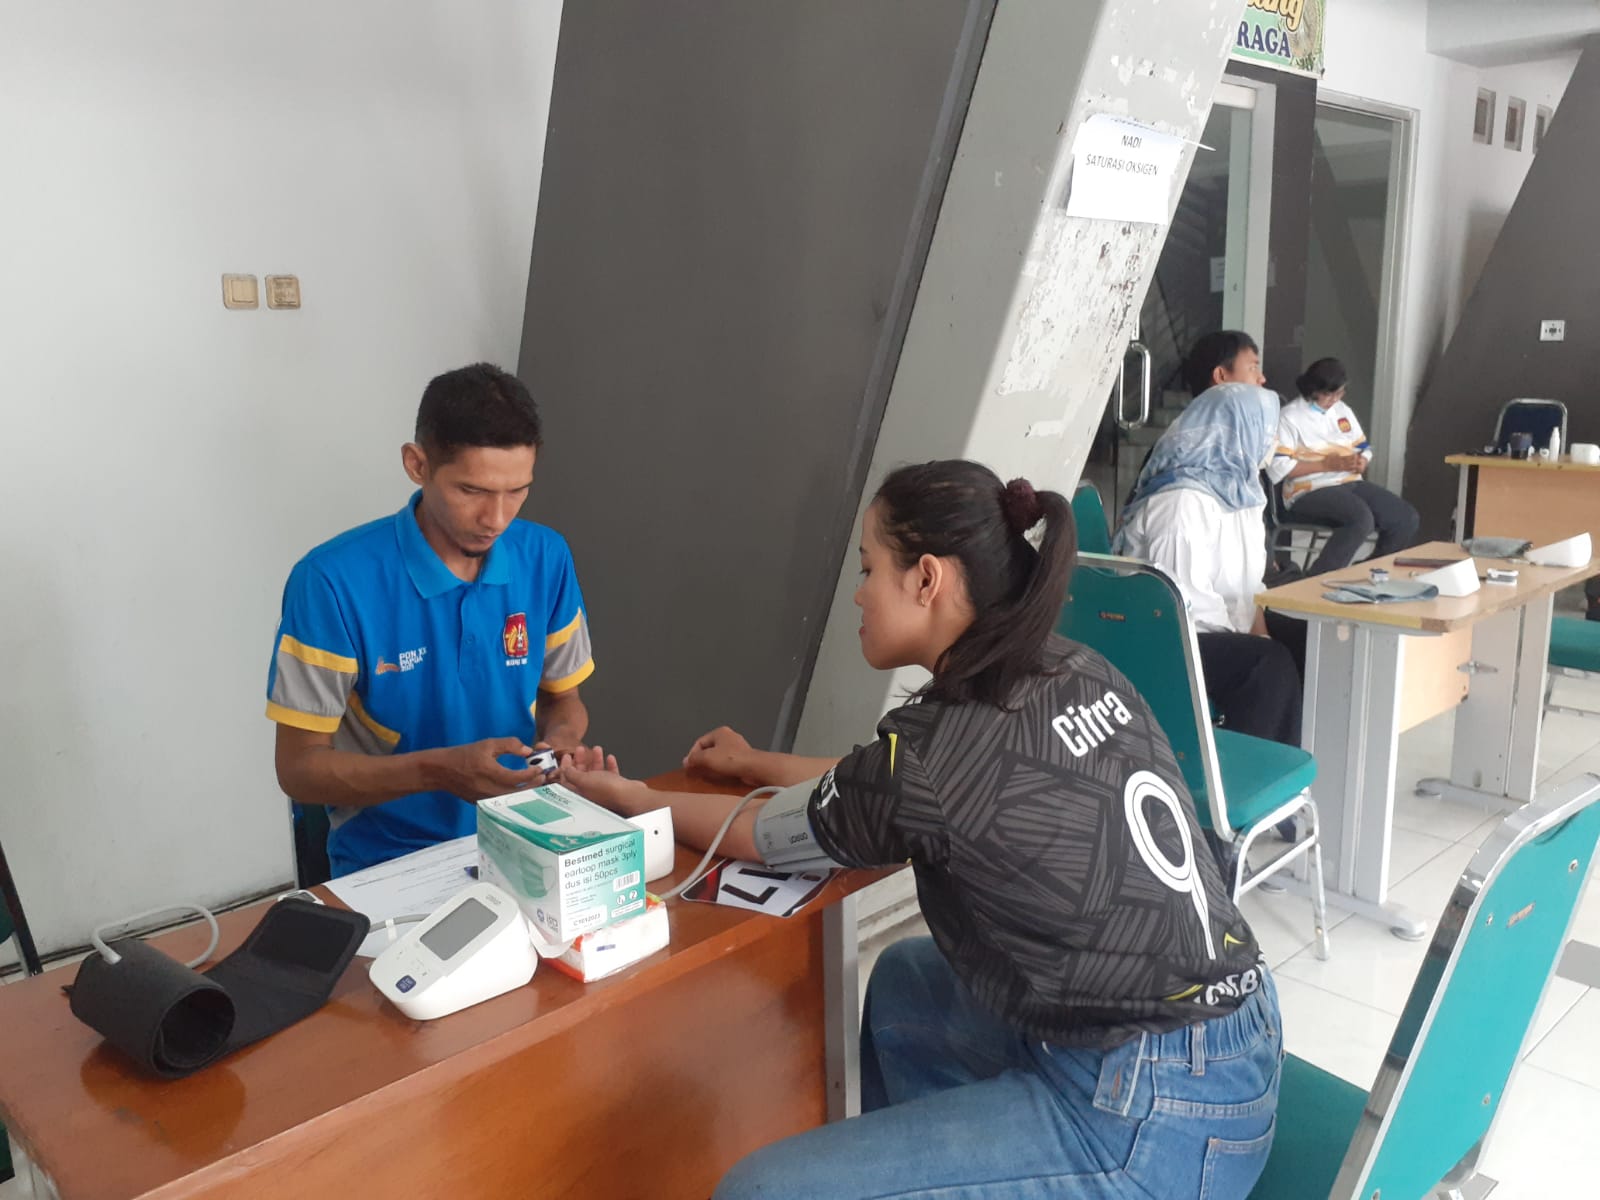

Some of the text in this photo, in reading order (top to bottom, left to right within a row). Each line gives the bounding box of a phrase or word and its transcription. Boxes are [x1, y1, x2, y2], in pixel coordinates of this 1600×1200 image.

[1237, 21, 1291, 58] RAGA
[1121, 134, 1142, 148] NADI
[1085, 153, 1159, 176] SATURASI OKSIGEN
[1052, 691, 1132, 757] Citra
[564, 838, 636, 867] Bestmed surgical
[564, 849, 637, 879] earloop mask 3ply
[1124, 770, 1216, 960] 9
[565, 867, 618, 889] dus isi 50pcs
